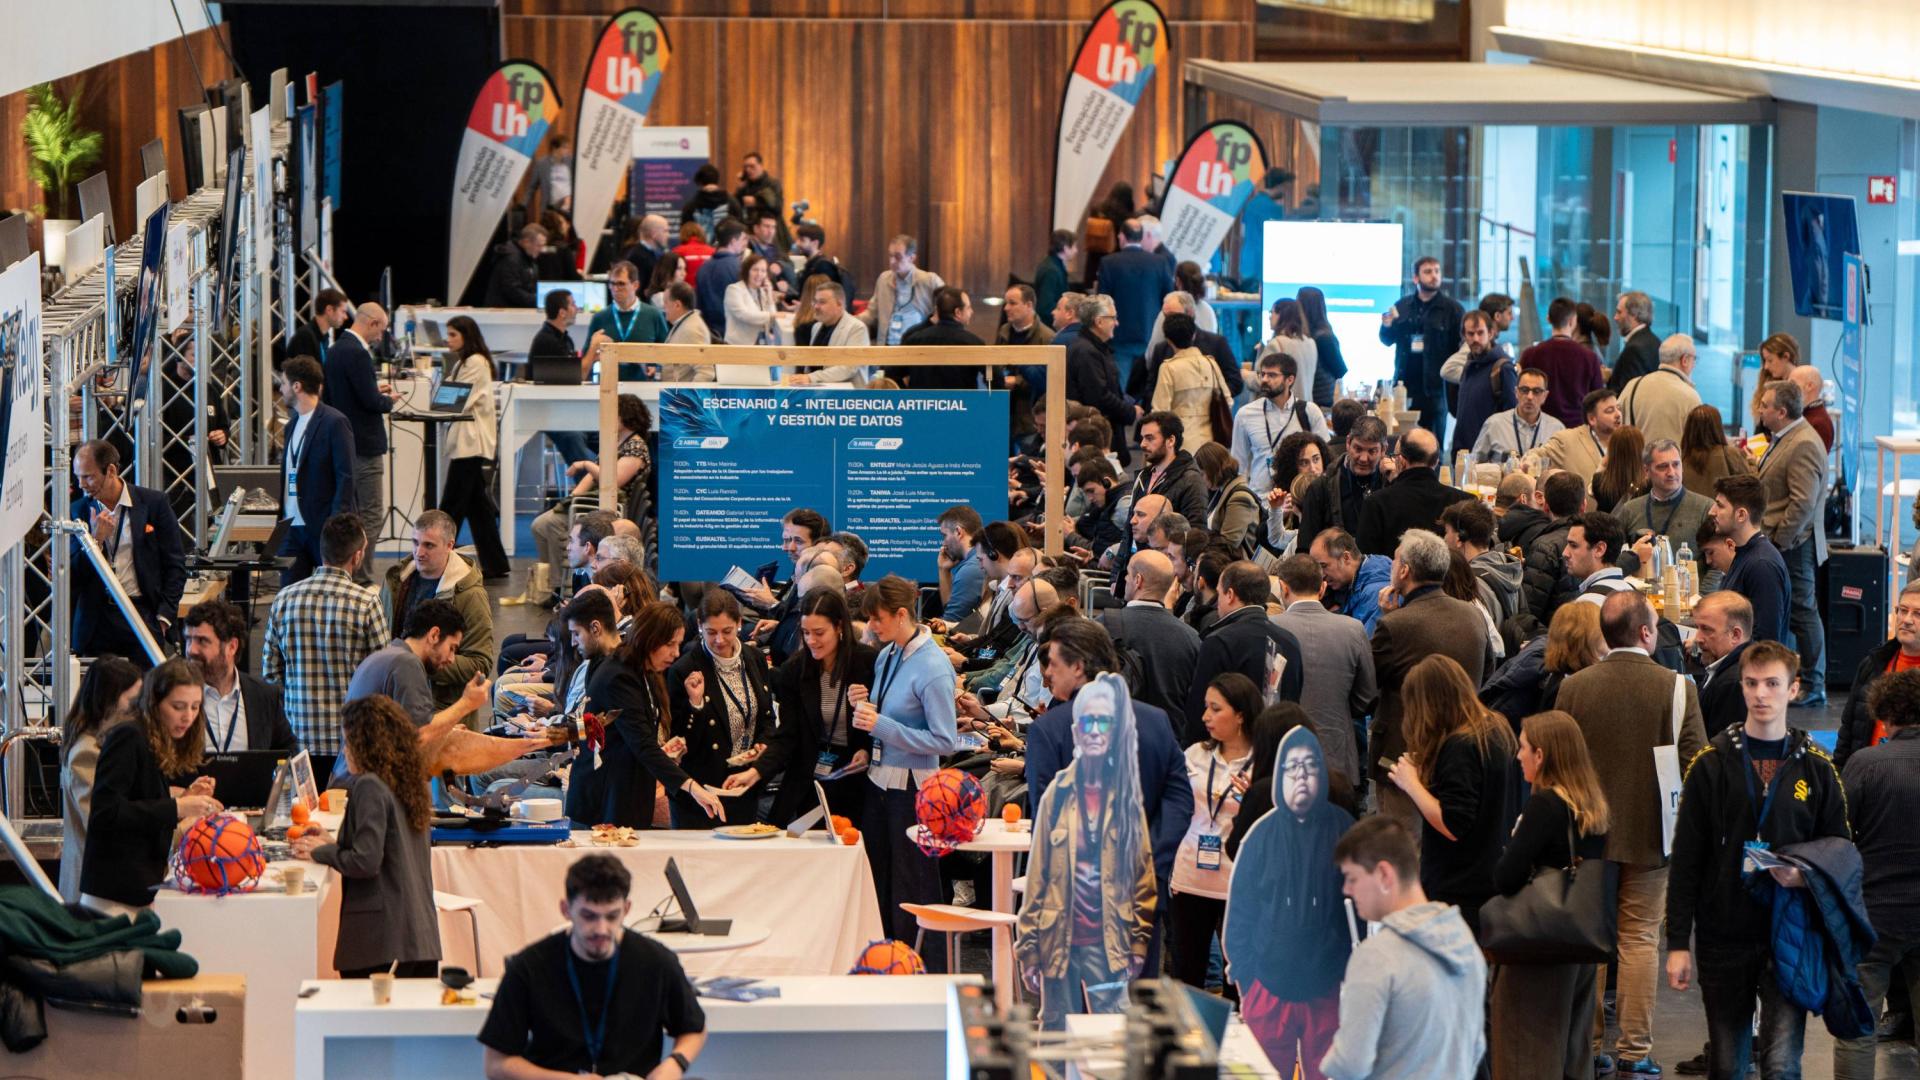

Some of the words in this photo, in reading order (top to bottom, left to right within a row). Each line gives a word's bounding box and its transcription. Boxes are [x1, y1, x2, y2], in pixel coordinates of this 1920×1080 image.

[622, 21, 657, 64] fp
[1117, 9, 1157, 53] fp
[606, 56, 643, 94] lh
[1096, 43, 1136, 85] lh
[507, 72, 544, 111] fp
[491, 103, 528, 137] lh
[581, 104, 609, 158] formación
[1064, 90, 1097, 143] formación
[461, 146, 488, 193] formación
[1216, 132, 1251, 170] fp
[1197, 161, 1232, 197] lh
[1167, 204, 1191, 246] ormación
[703, 398, 777, 410] ESCENARIO
[780, 398, 789, 410] 4
[805, 399, 894, 411] INTELIGENCIA
[897, 399, 967, 411] ARTIFICIAL
[767, 414, 776, 426] Y
[779, 412, 835, 426] GESTIÓN
[839, 415, 856, 427] DE
[860, 415, 903, 427] DATOS
[882, 439, 892, 447] DÍA
[728, 536, 750, 544] Santiago
